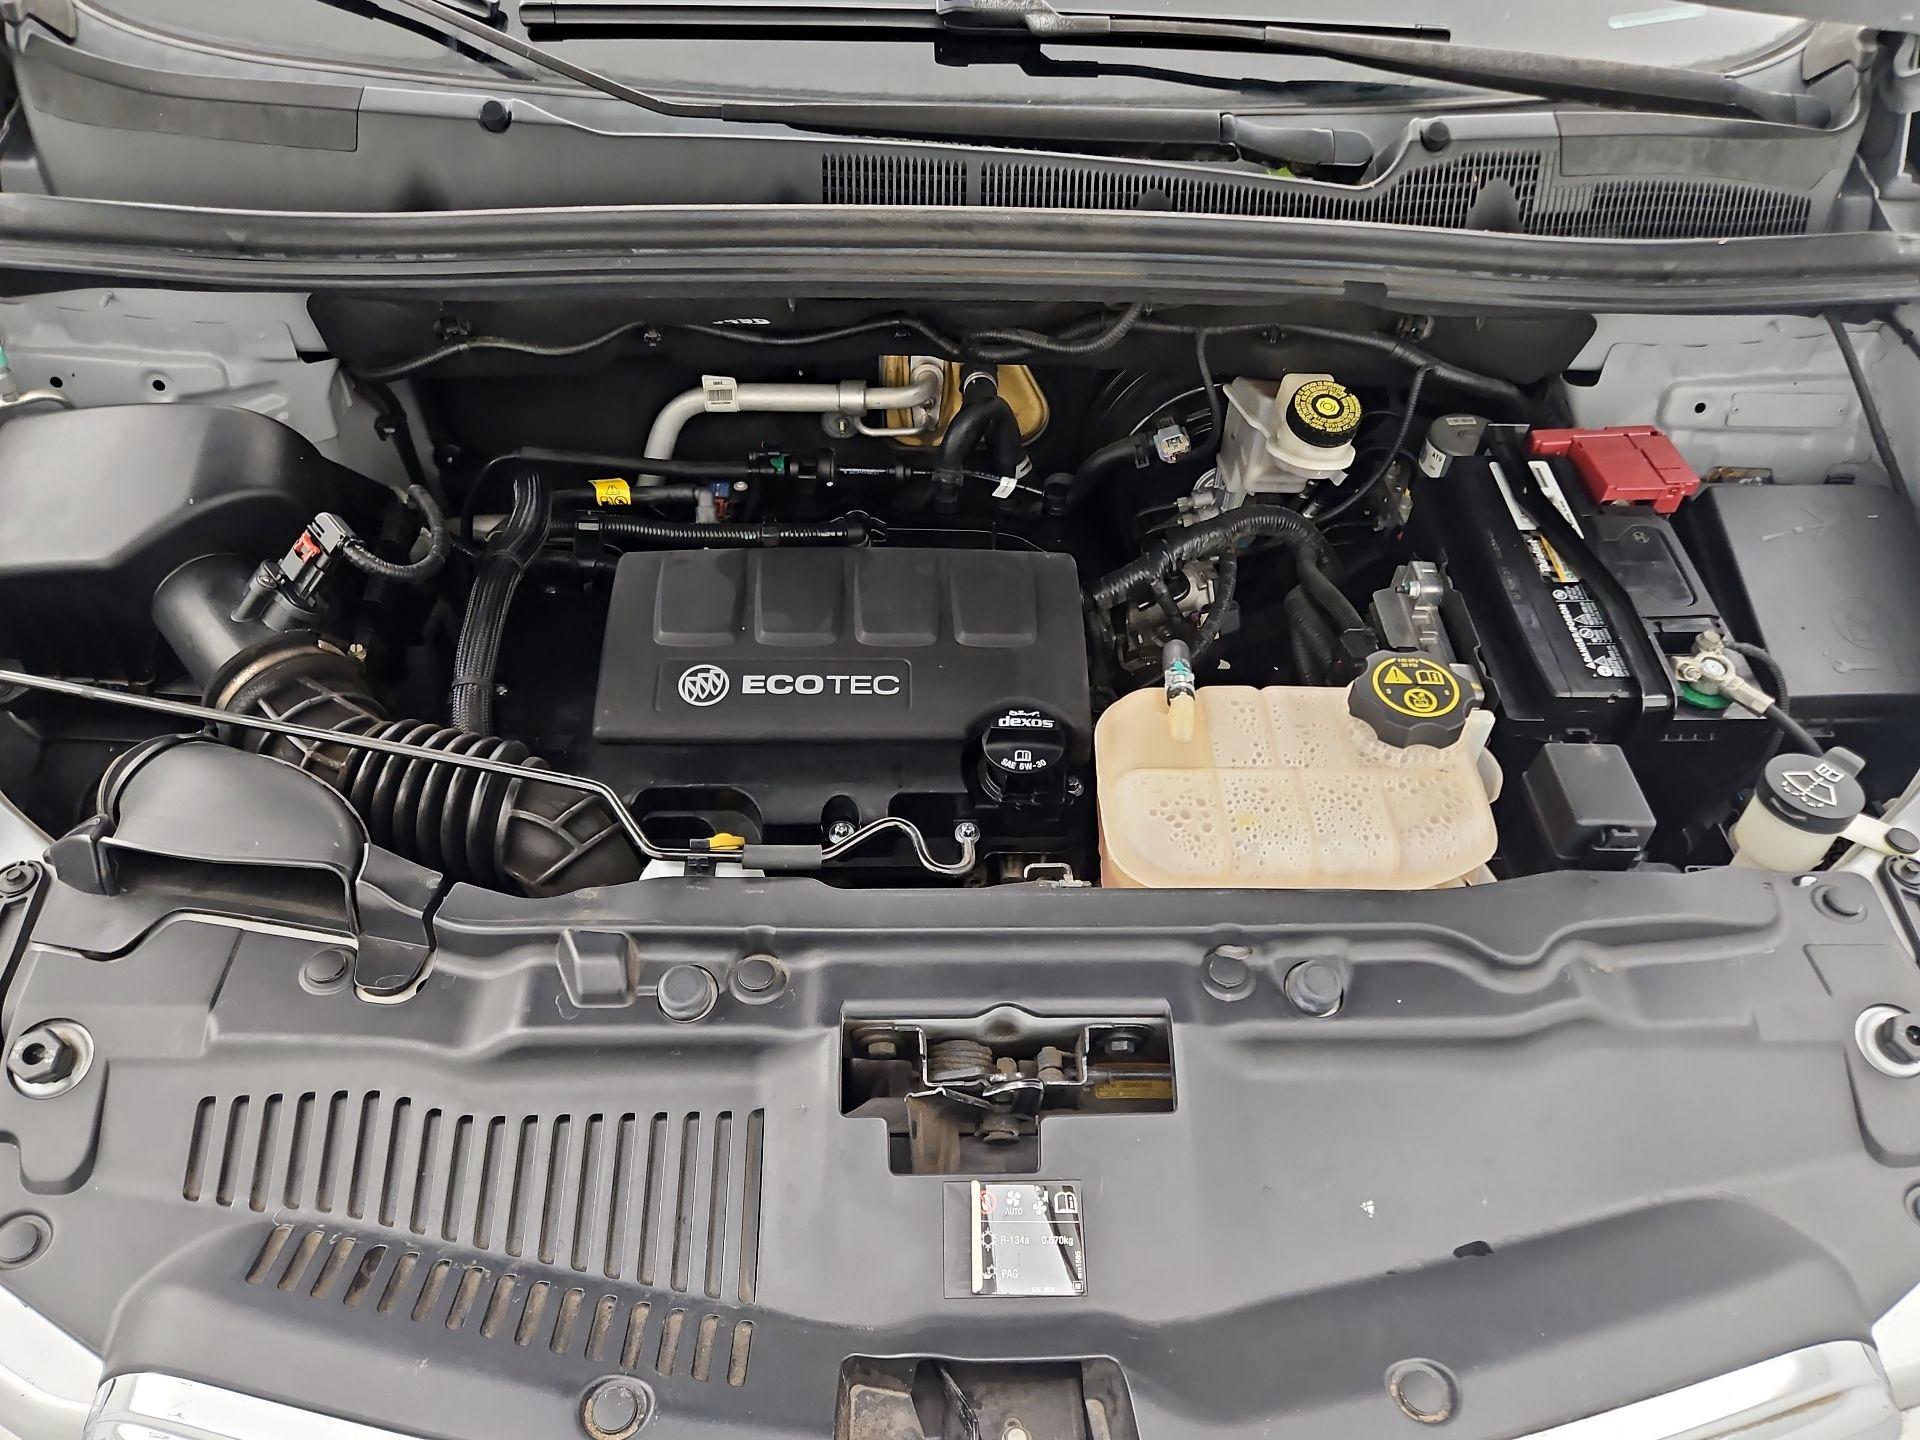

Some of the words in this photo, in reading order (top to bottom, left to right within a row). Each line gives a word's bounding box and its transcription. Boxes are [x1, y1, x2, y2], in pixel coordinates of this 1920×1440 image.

[741, 674, 900, 695] ECOTEC
[998, 715, 1055, 728] dexos
[1000, 758, 1017, 770] SAE
[1018, 759, 1047, 771] 5W-30
[1004, 1207, 1023, 1216] AUTO
[1000, 1235, 1030, 1245] R-134a
[1001, 1268, 1019, 1279] PAG
